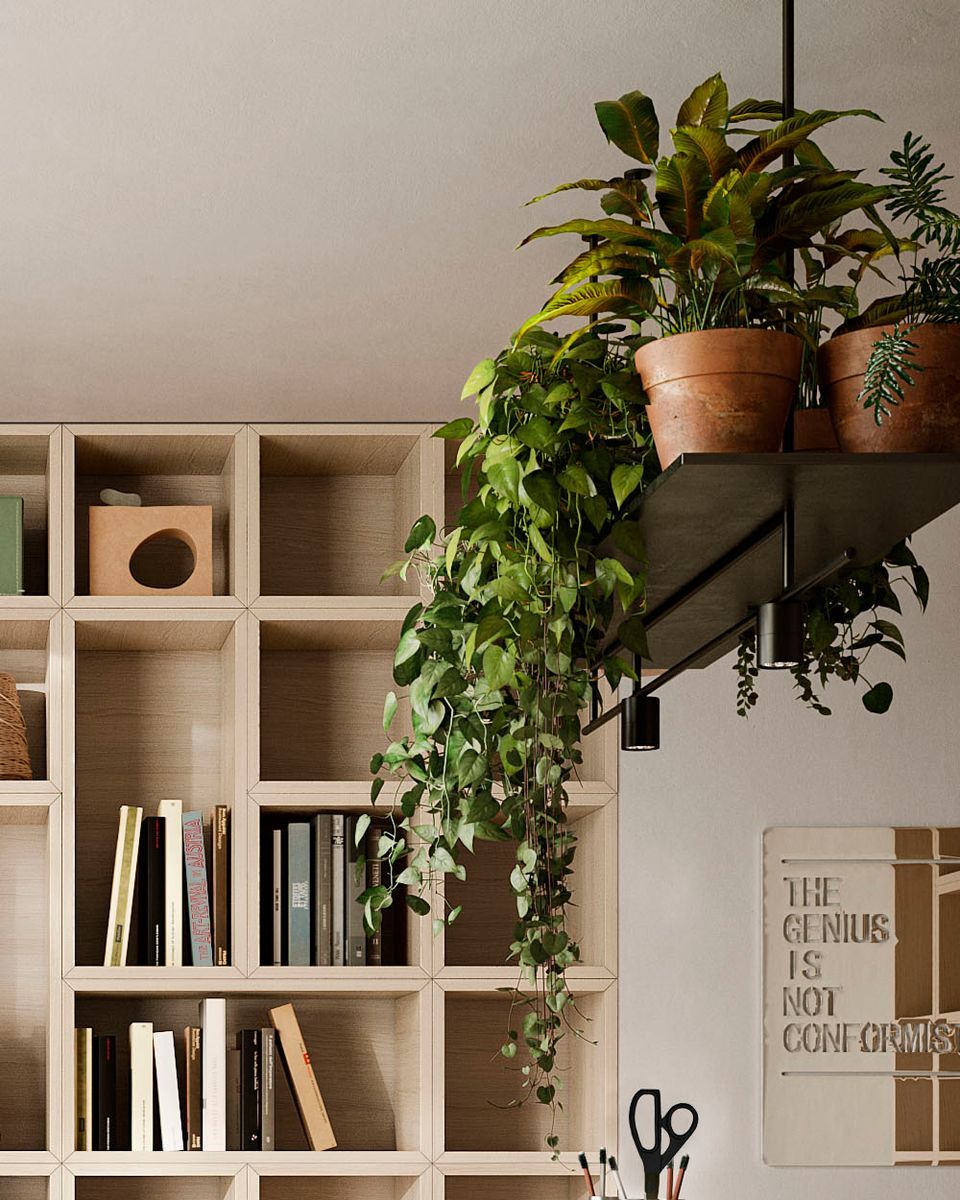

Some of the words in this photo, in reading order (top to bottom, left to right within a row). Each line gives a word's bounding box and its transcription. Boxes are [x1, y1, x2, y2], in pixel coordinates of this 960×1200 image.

[783, 877, 843, 907] THE
[782, 913, 891, 945] GENIUS
[789, 950, 824, 981] IS
[782, 986, 843, 1017] NOT
